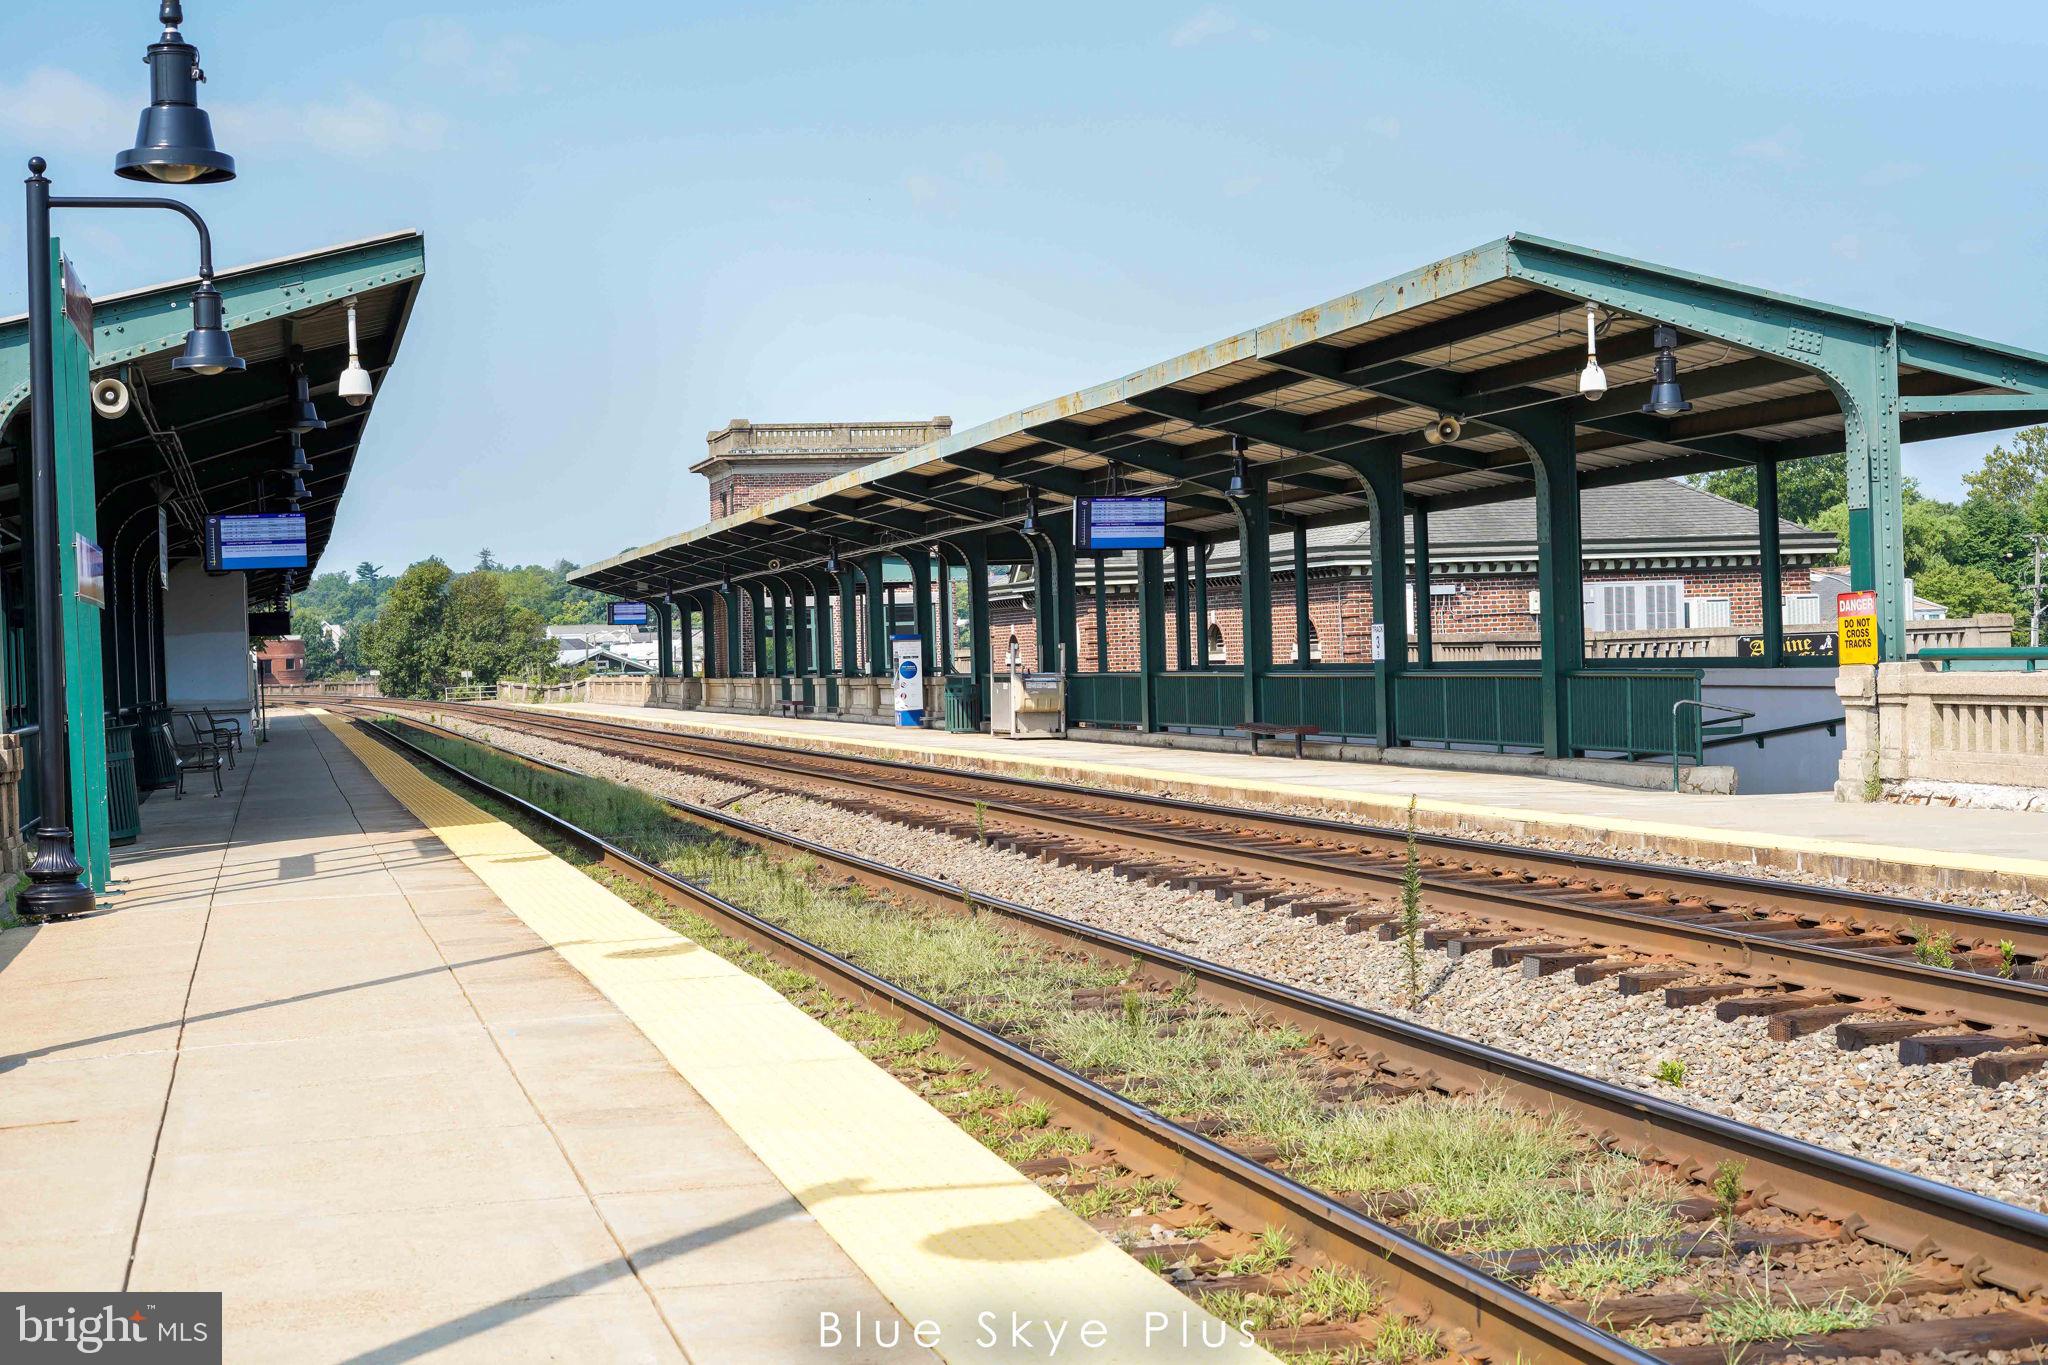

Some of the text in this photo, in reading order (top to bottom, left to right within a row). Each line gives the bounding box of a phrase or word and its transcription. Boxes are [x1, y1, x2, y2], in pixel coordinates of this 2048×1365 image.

[1839, 598, 1874, 611] DANGER
[1844, 618, 1871, 628] DO NOT
[1846, 628, 1870, 638] CROSS
[1844, 638, 1872, 649] TRACKS
